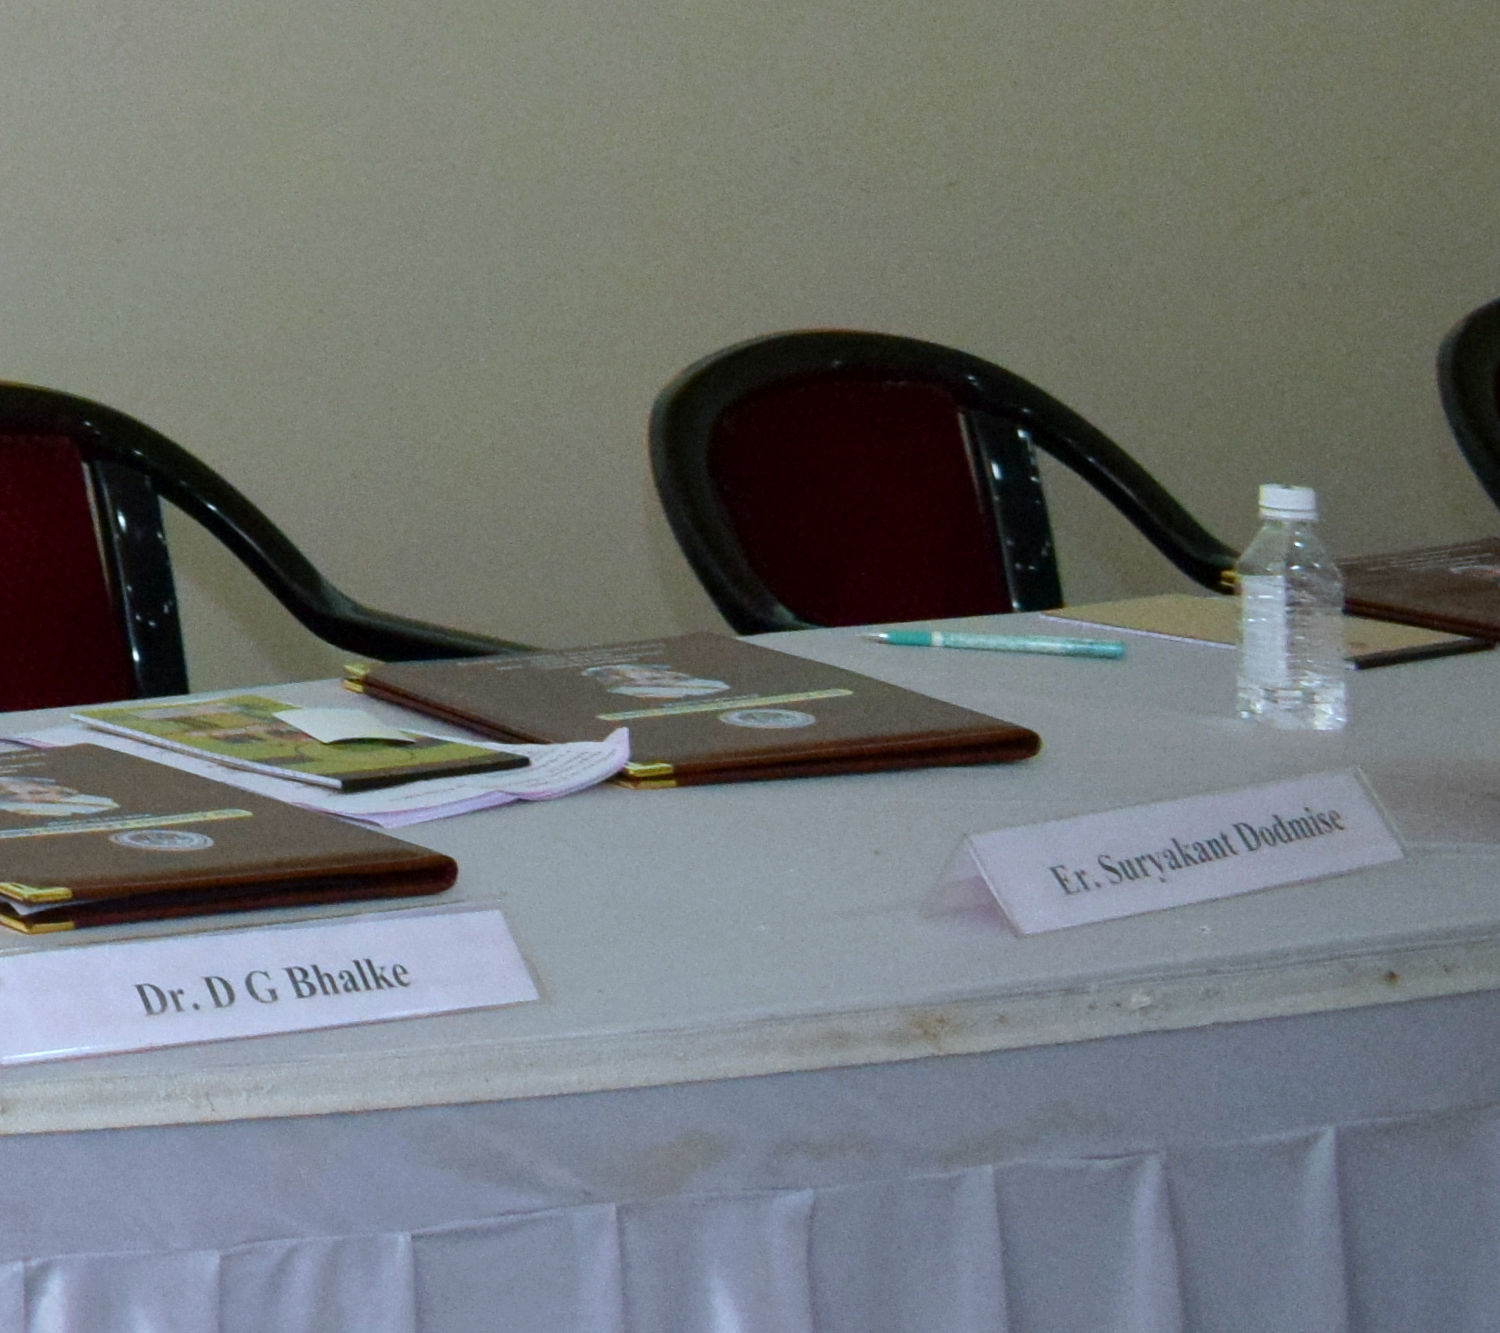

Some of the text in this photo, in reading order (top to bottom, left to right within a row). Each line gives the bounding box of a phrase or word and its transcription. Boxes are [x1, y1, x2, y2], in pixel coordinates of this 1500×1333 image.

[1049, 803, 1346, 898] Er. Suryakant Dodmise
[133, 957, 412, 1020] Dr. D G Bhalke
